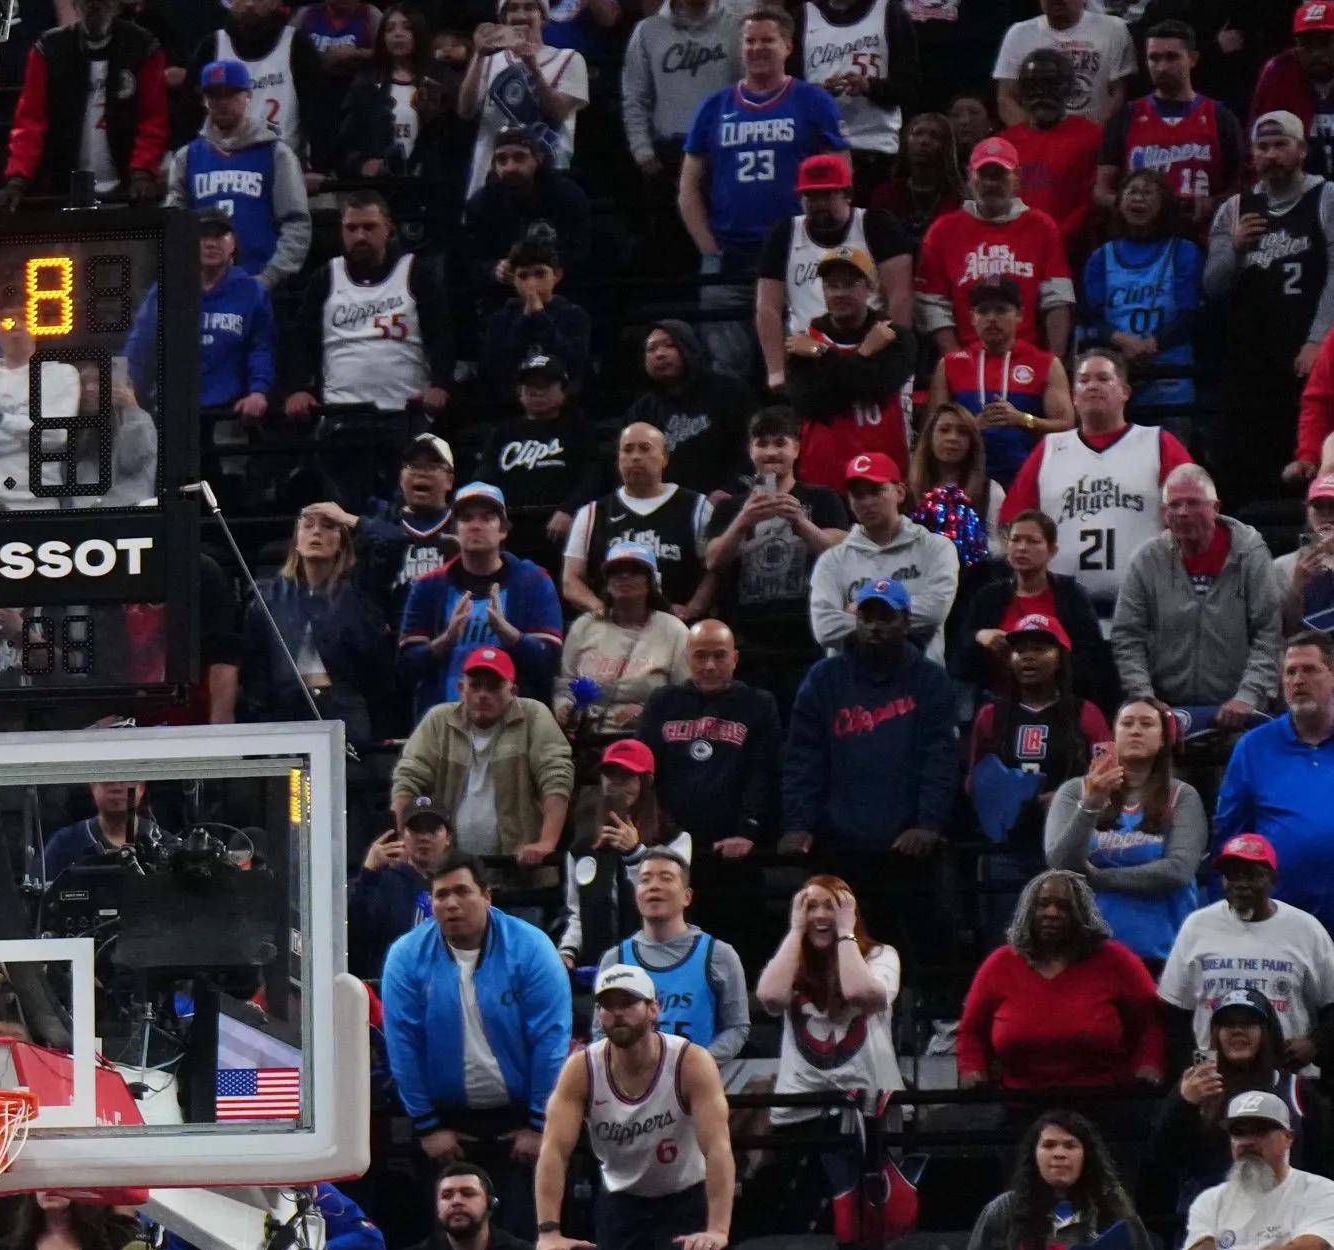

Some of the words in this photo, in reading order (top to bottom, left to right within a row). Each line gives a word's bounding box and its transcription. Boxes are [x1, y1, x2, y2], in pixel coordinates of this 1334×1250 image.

[662, 42, 727, 78] Clips
[808, 35, 879, 76] Clippers
[721, 117, 795, 148] CLIPPERS
[737, 148, 775, 183] 23
[196, 169, 266, 199] CLIPPERS
[1180, 168, 1210, 197] 12
[1285, 262, 1305, 297] 2
[330, 294, 405, 328] Clippers
[373, 314, 408, 340] 55
[499, 440, 566, 471] Clips
[1074, 477, 1114, 500] Los
[1056, 488, 1145, 523] Angeles
[1078, 528, 1117, 571] 21
[1201, 957, 1237, 973] BREAK
[1238, 957, 1258, 973] THE
[1260, 957, 1295, 974] PAINT
[1217, 978, 1243, 993] THE
[595, 1110, 677, 1146] Clippers
[655, 1137, 674, 1165] 6
